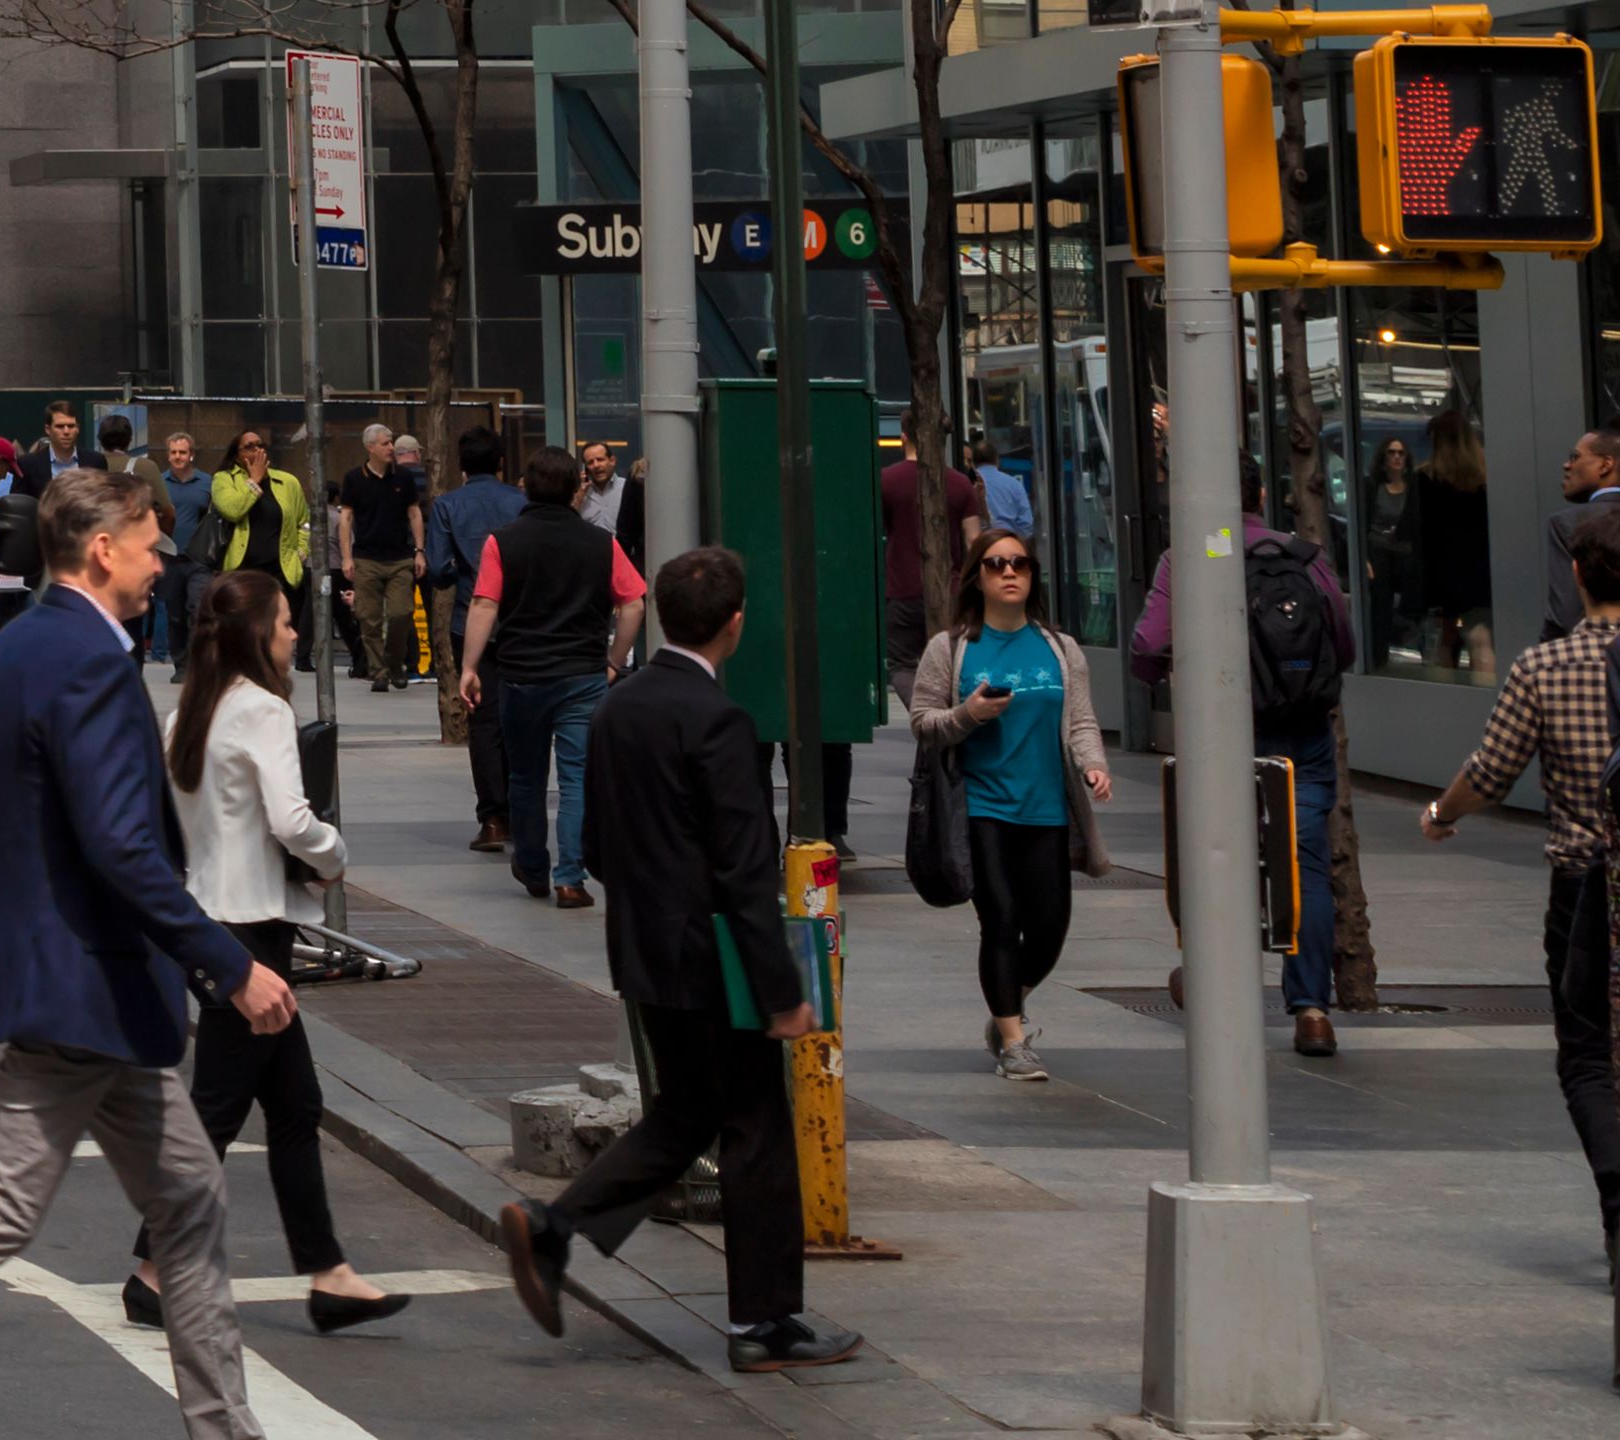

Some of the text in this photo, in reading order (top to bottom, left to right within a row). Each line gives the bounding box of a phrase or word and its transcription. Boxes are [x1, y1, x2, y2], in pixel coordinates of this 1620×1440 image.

[311, 73, 330, 82] etered
[311, 105, 345, 121] MERCIAL
[312, 124, 354, 141] CLES ONLY
[327, 150, 356, 161] STANDING
[557, 213, 722, 263] Suby
[745, 224, 760, 247] E
[849, 222, 865, 245] 6
[316, 242, 348, 263] 477
